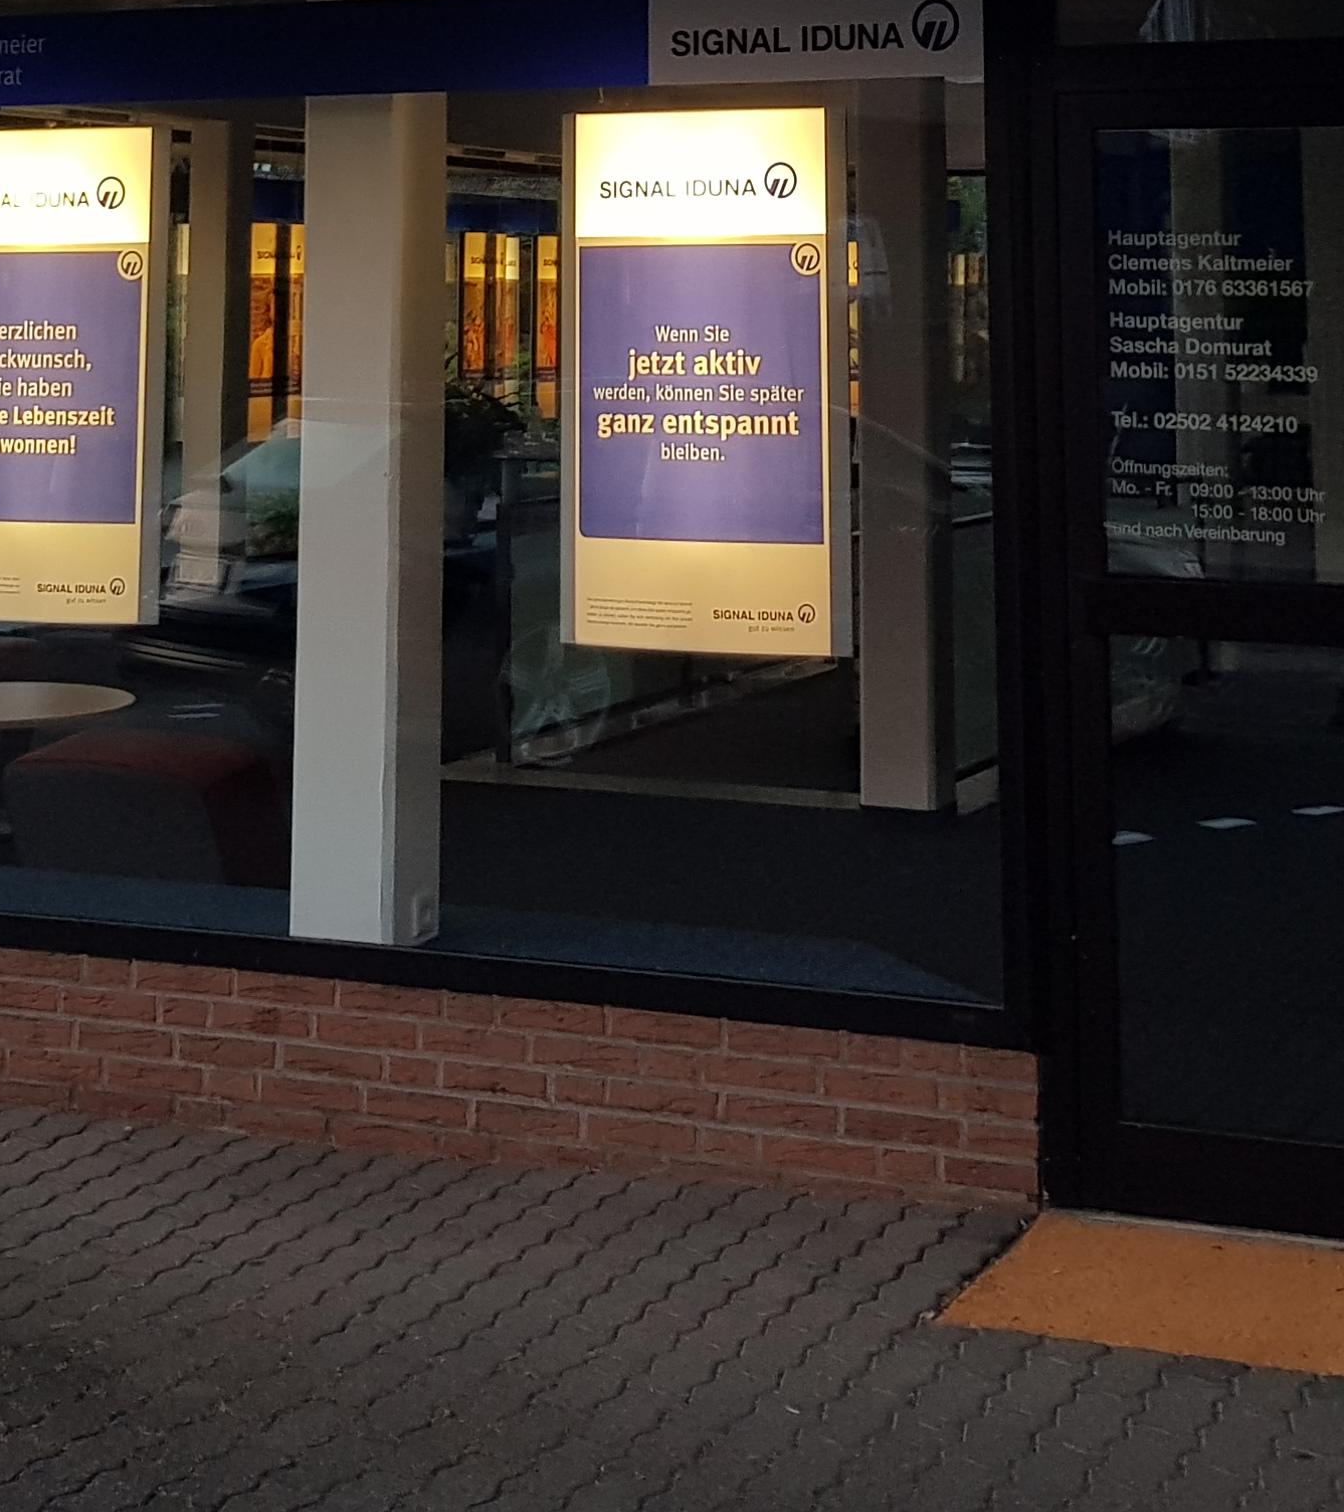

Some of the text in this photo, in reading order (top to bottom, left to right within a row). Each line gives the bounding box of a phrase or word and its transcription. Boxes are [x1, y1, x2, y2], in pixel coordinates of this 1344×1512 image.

[671, 22, 905, 57] SIGNAL IDUNA
[599, 178, 757, 199] SIGNAL IDUNA
[30, 191, 90, 208] DUNA
[1108, 230, 1242, 249] Hauptagentur
[1108, 254, 1294, 272] Clemens Kaltmeier
[1108, 278, 1314, 297] Mobil: 0176 63361567
[1109, 312, 1244, 333] Hauptagentur
[655, 325, 730, 342] Wenn Sie
[1109, 336, 1273, 356] Sascha Domurat
[628, 348, 761, 381] jetzt aktiv
[1110, 361, 1318, 384] Mobil: 0151 52234339
[17, 377, 72, 397] haben
[593, 384, 804, 405] werden, können Sie später
[13, 405, 115, 426] Lebenszeit
[597, 410, 800, 441] ganz entspannt
[1111, 411, 1299, 434] Tel.: 02502 4124210
[660, 443, 726, 461] bleiben.
[1112, 456, 1229, 478] Öffnungszeiten:
[1112, 480, 1140, 495] Mo.
[1155, 481, 1173, 496] Fr.
[1189, 483, 1234, 498] 09:00
[1249, 485, 1292, 501] 13:00
[1296, 487, 1326, 502] Uhr
[1191, 504, 1233, 519] 15:00
[1250, 507, 1293, 523] 18:00
[1297, 509, 1326, 524] Uhr
[1112, 521, 1286, 545] und nach Vereinbarung
[37, 583, 107, 595] SIGNAL IDUNA
[713, 609, 794, 622] SIGNAL IDUNA
